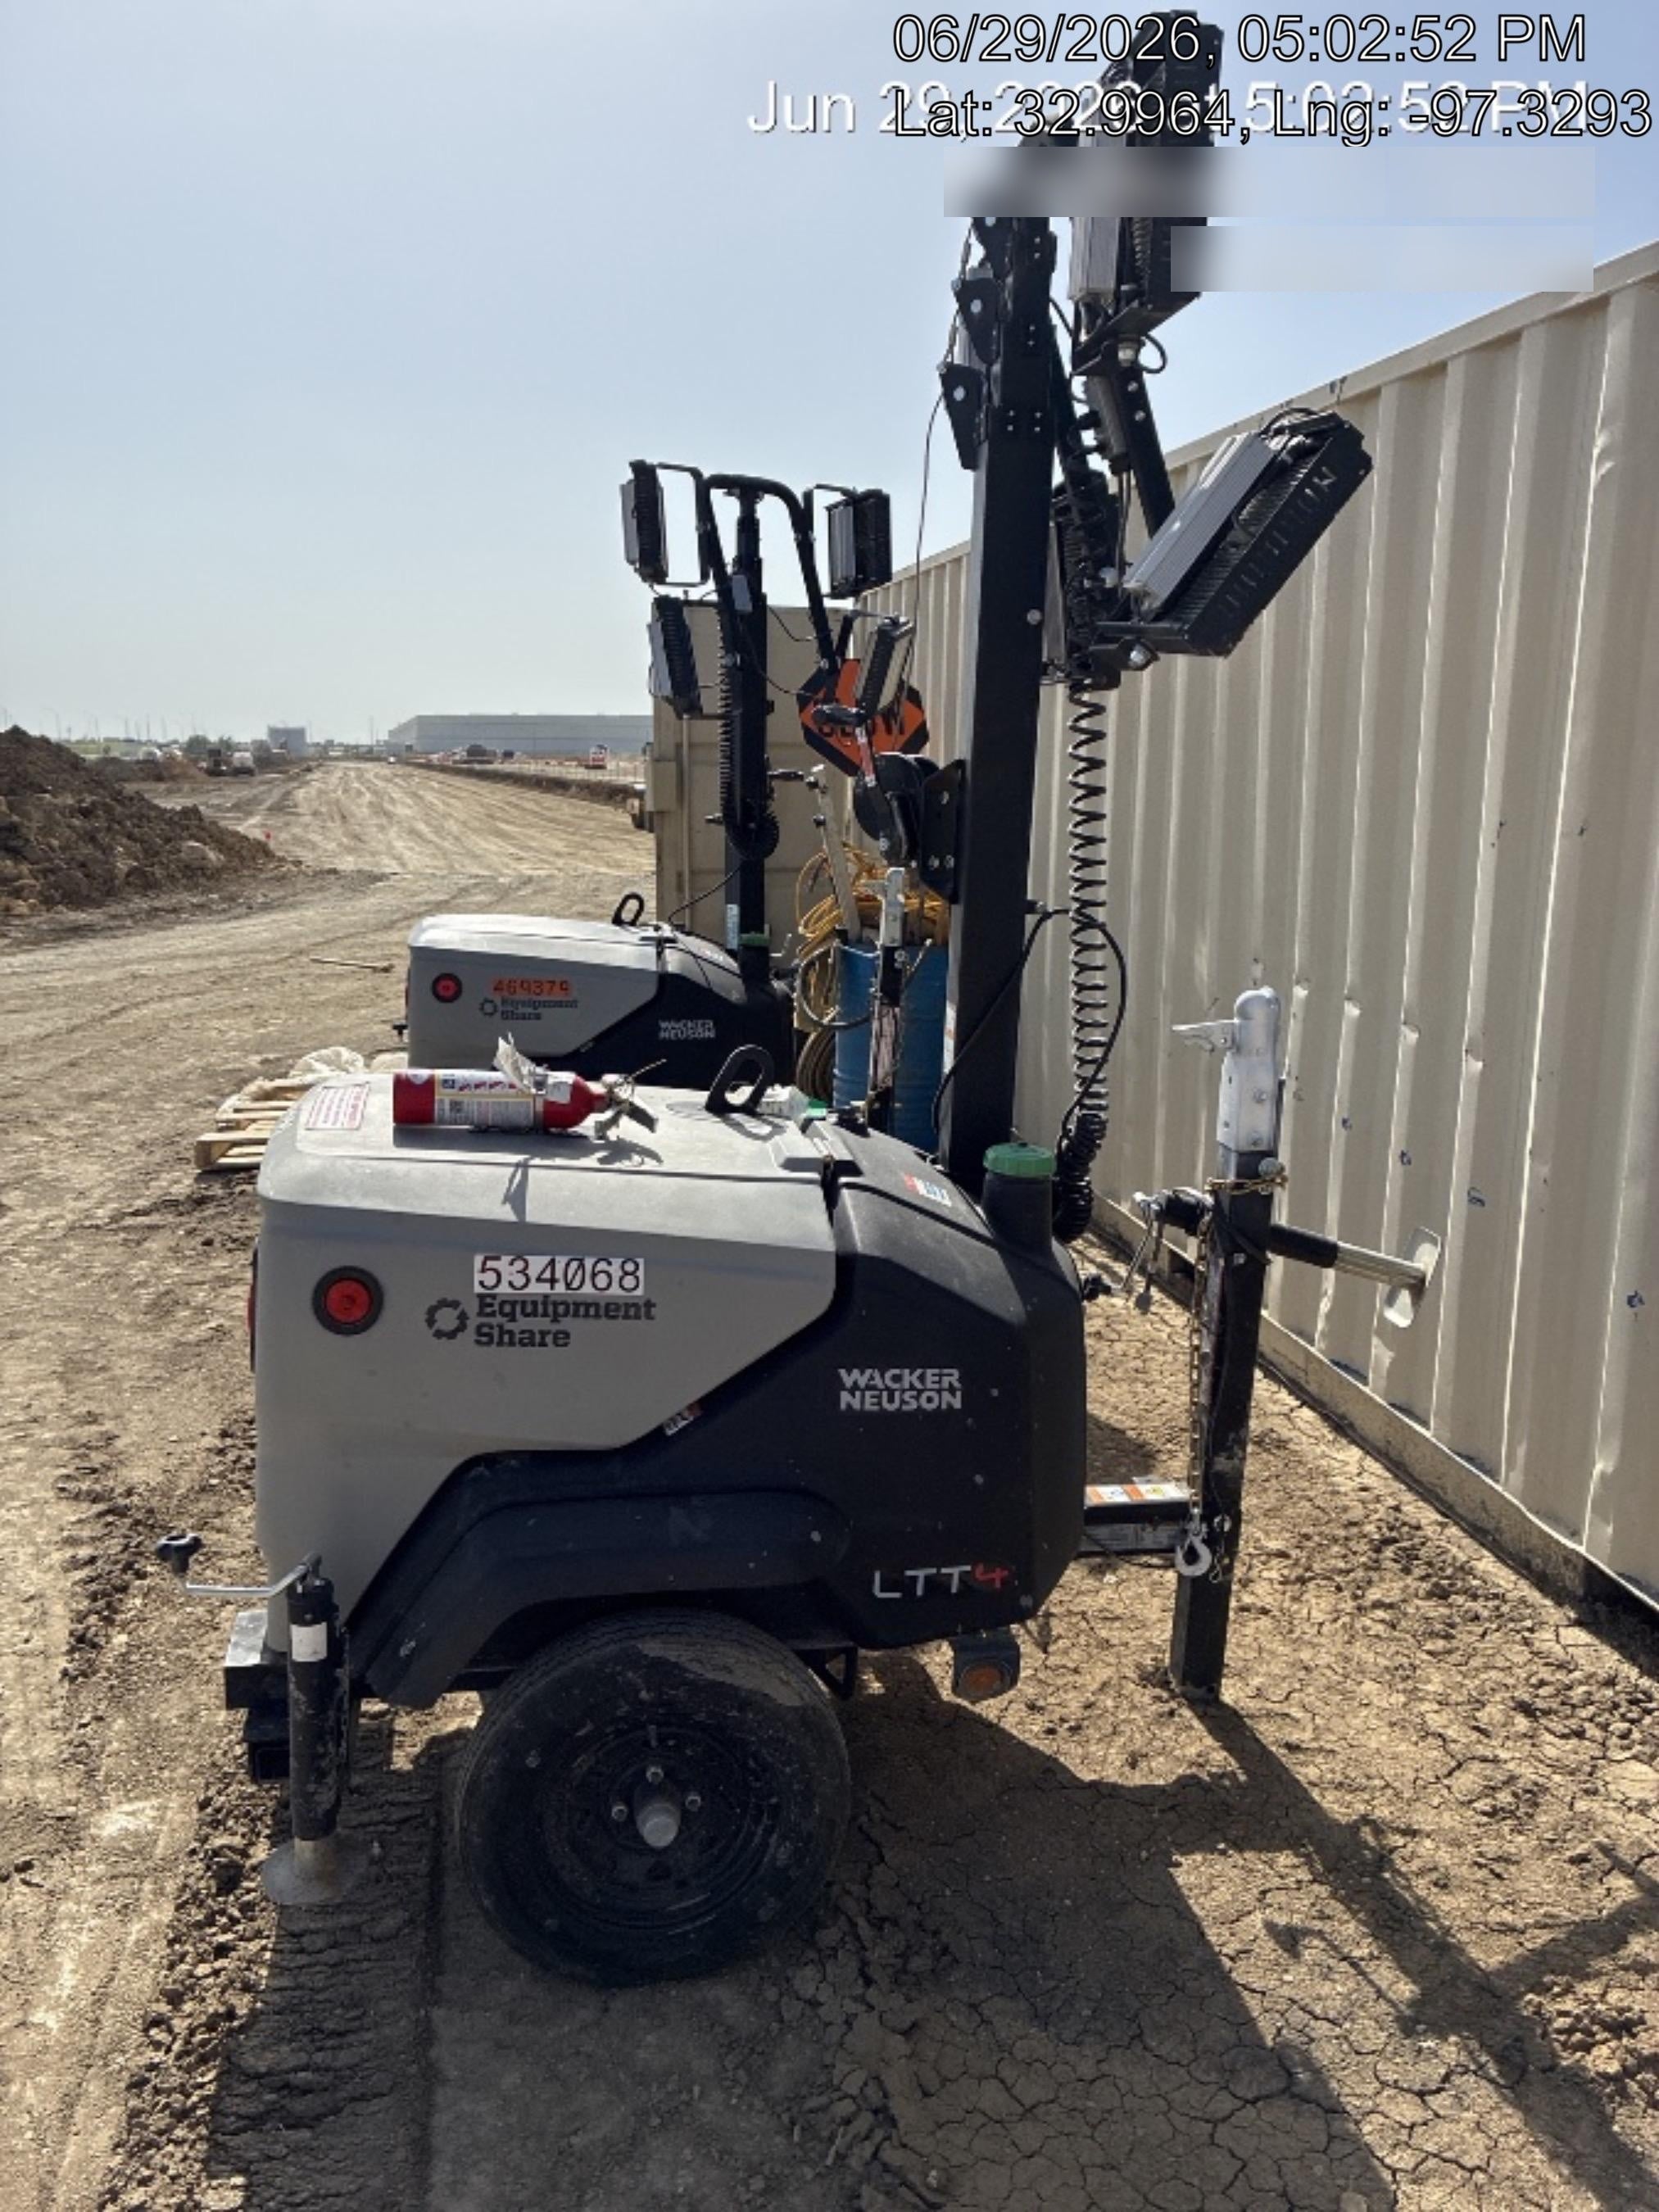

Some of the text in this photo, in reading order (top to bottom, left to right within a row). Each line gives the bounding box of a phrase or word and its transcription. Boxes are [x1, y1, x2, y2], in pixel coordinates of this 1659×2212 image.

[478, 1255, 641, 1292] 534068
[475, 1294, 657, 1322] Equipment
[474, 1322, 571, 1348] Share
[838, 1368, 962, 1389] WACKER
[840, 1390, 962, 1411] NEUSON
[873, 1563, 1009, 1598] LTT4
